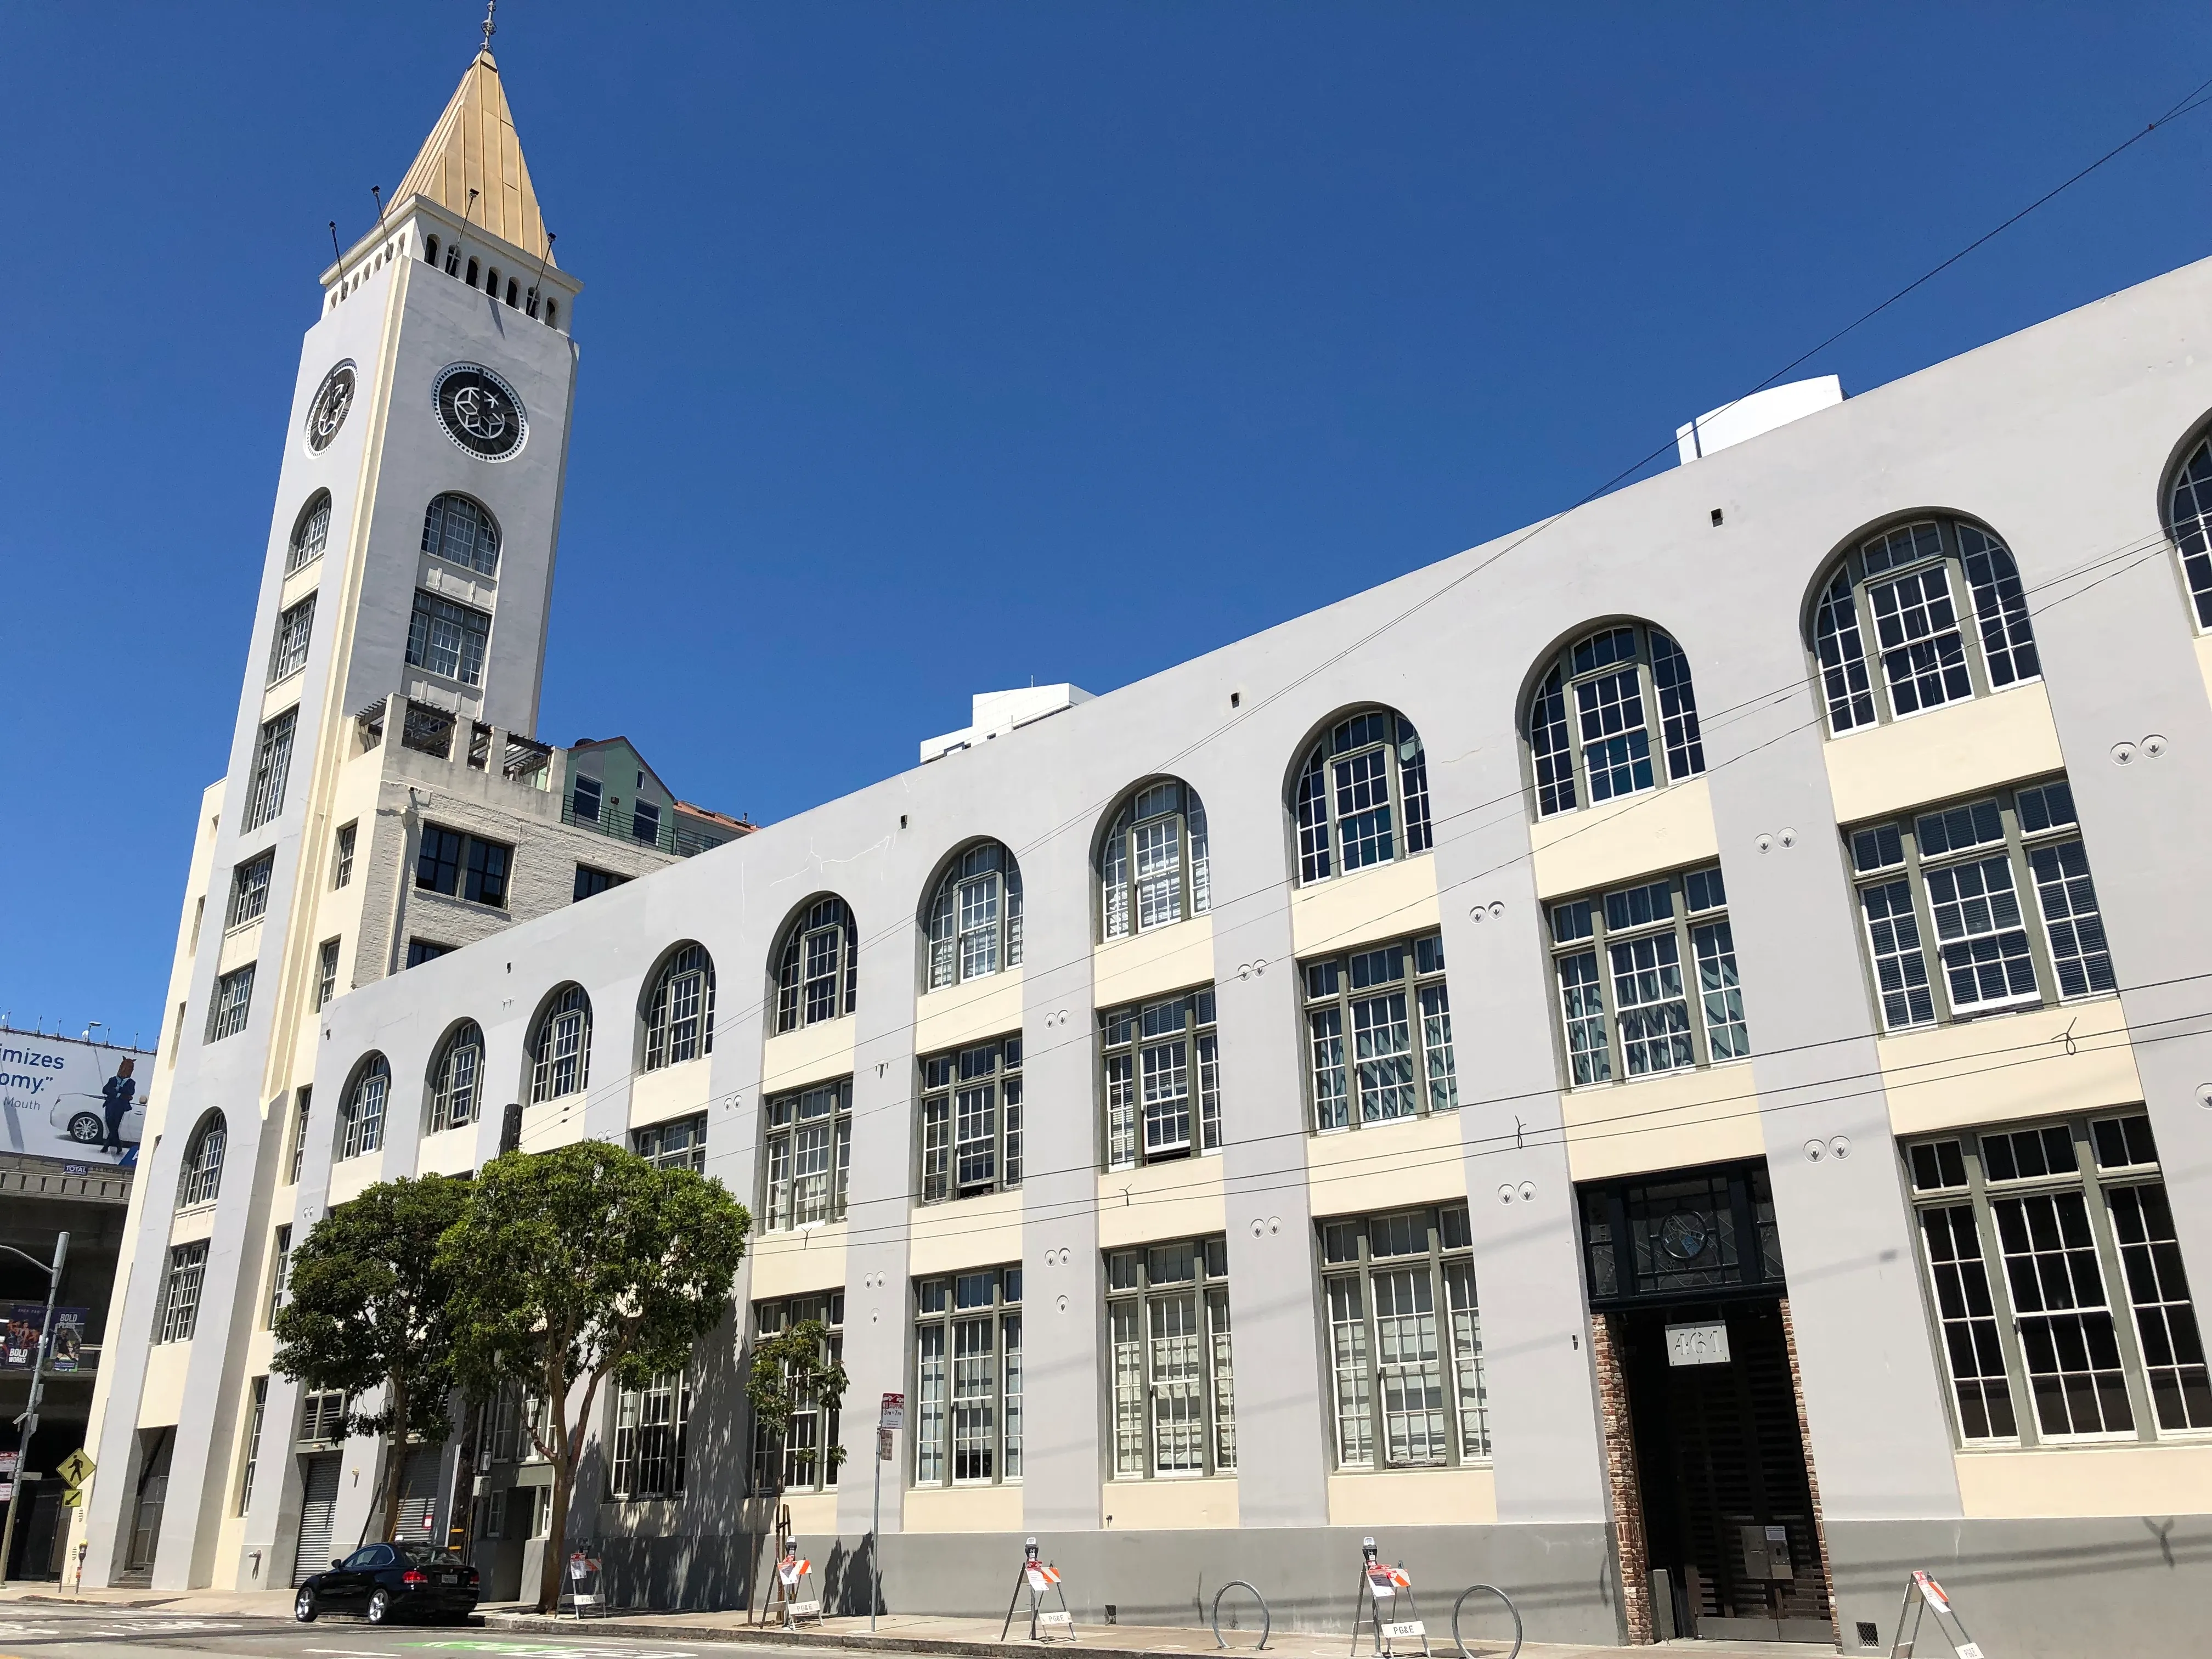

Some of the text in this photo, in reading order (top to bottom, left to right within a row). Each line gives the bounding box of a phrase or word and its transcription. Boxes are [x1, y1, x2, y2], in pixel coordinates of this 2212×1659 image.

[4, 1097, 40, 1110] Mouth
[60, 1313, 78, 1322] BOLD
[1675, 1330, 1722, 1355] 461
[9, 1348, 27, 1357] BOLD
[797, 1604, 813, 1612] PG&E
[1393, 1625, 1414, 1635] PG&E
